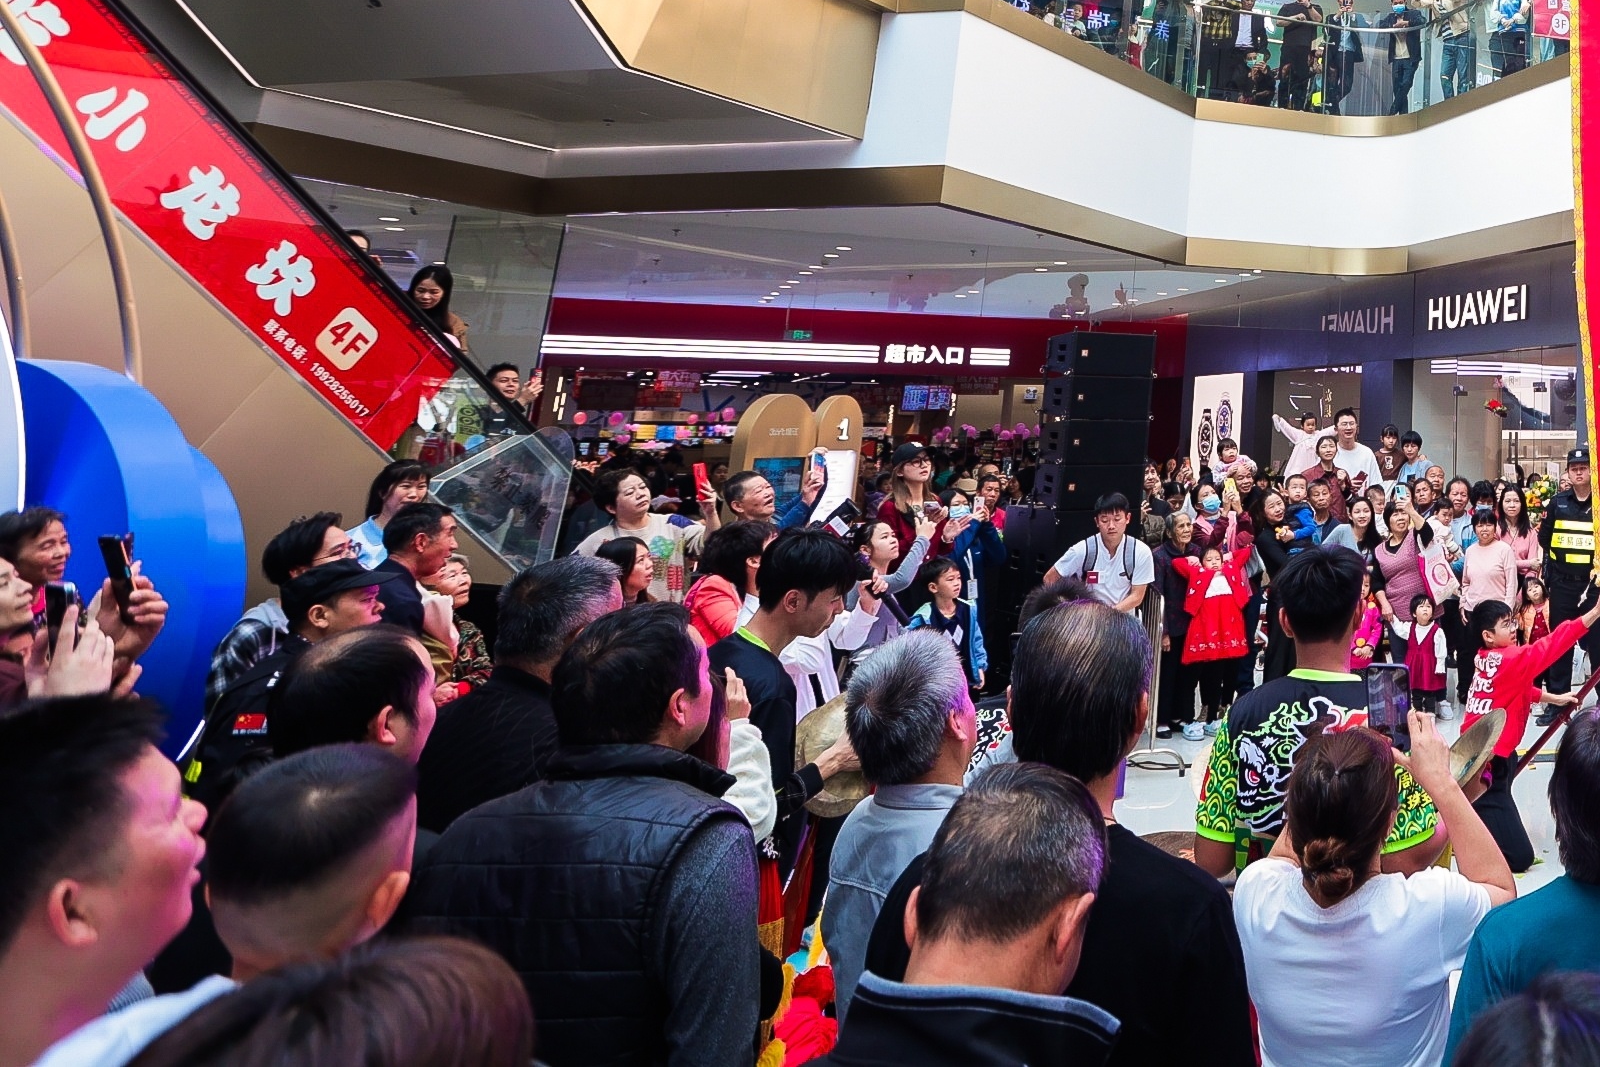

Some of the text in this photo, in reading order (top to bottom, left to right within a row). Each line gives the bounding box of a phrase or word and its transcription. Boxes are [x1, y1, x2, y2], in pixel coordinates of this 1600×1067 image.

[1554, 18, 1567, 29] 3F
[1428, 284, 1527, 331] HUAWEI
[329, 321, 370, 355] 4F
[884, 344, 964, 364] 超市入口
[309, 362, 370, 417] 19928255017
[838, 418, 849, 440] 1
